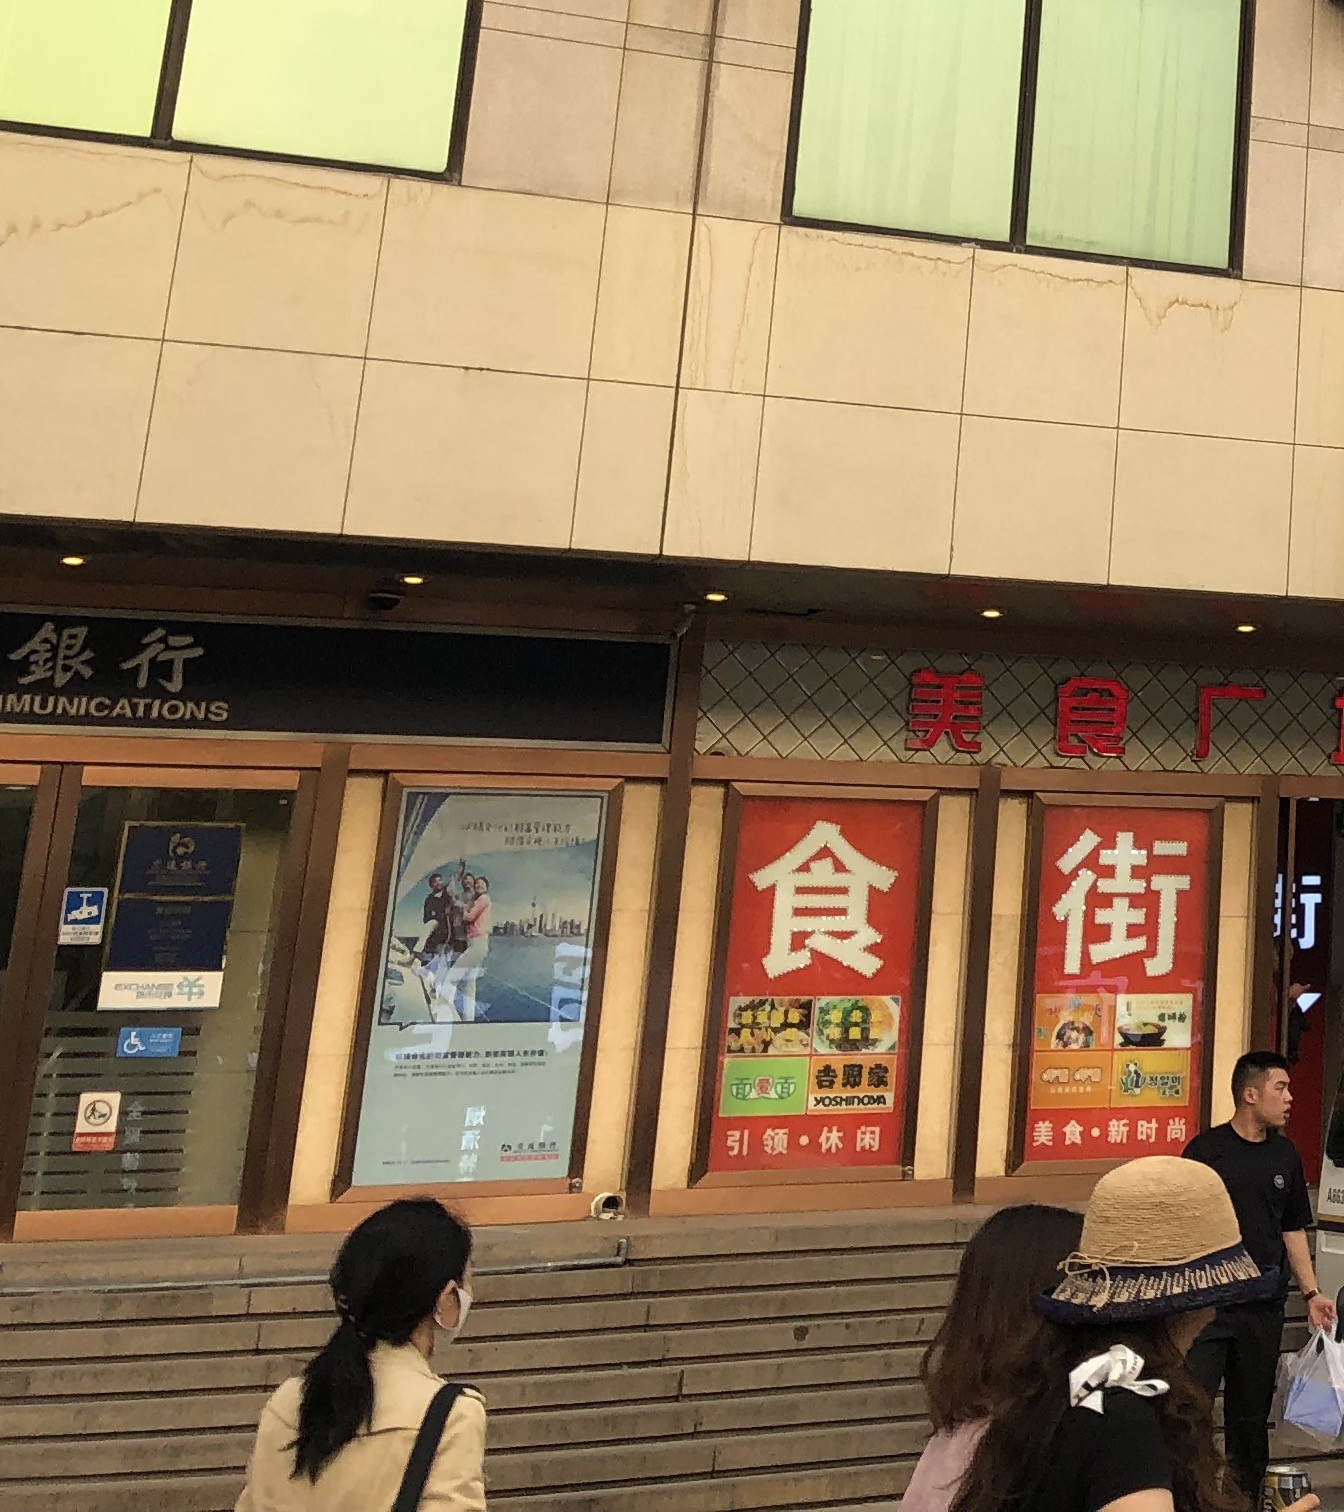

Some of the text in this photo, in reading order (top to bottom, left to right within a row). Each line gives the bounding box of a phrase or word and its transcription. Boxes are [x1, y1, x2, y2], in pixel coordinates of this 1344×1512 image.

[8, 622, 205, 693] 銀行
[0, 693, 230, 722] MUNICATIONS
[747, 819, 1192, 980] 食 街
[815, 1063, 890, 1090] 吉野家
